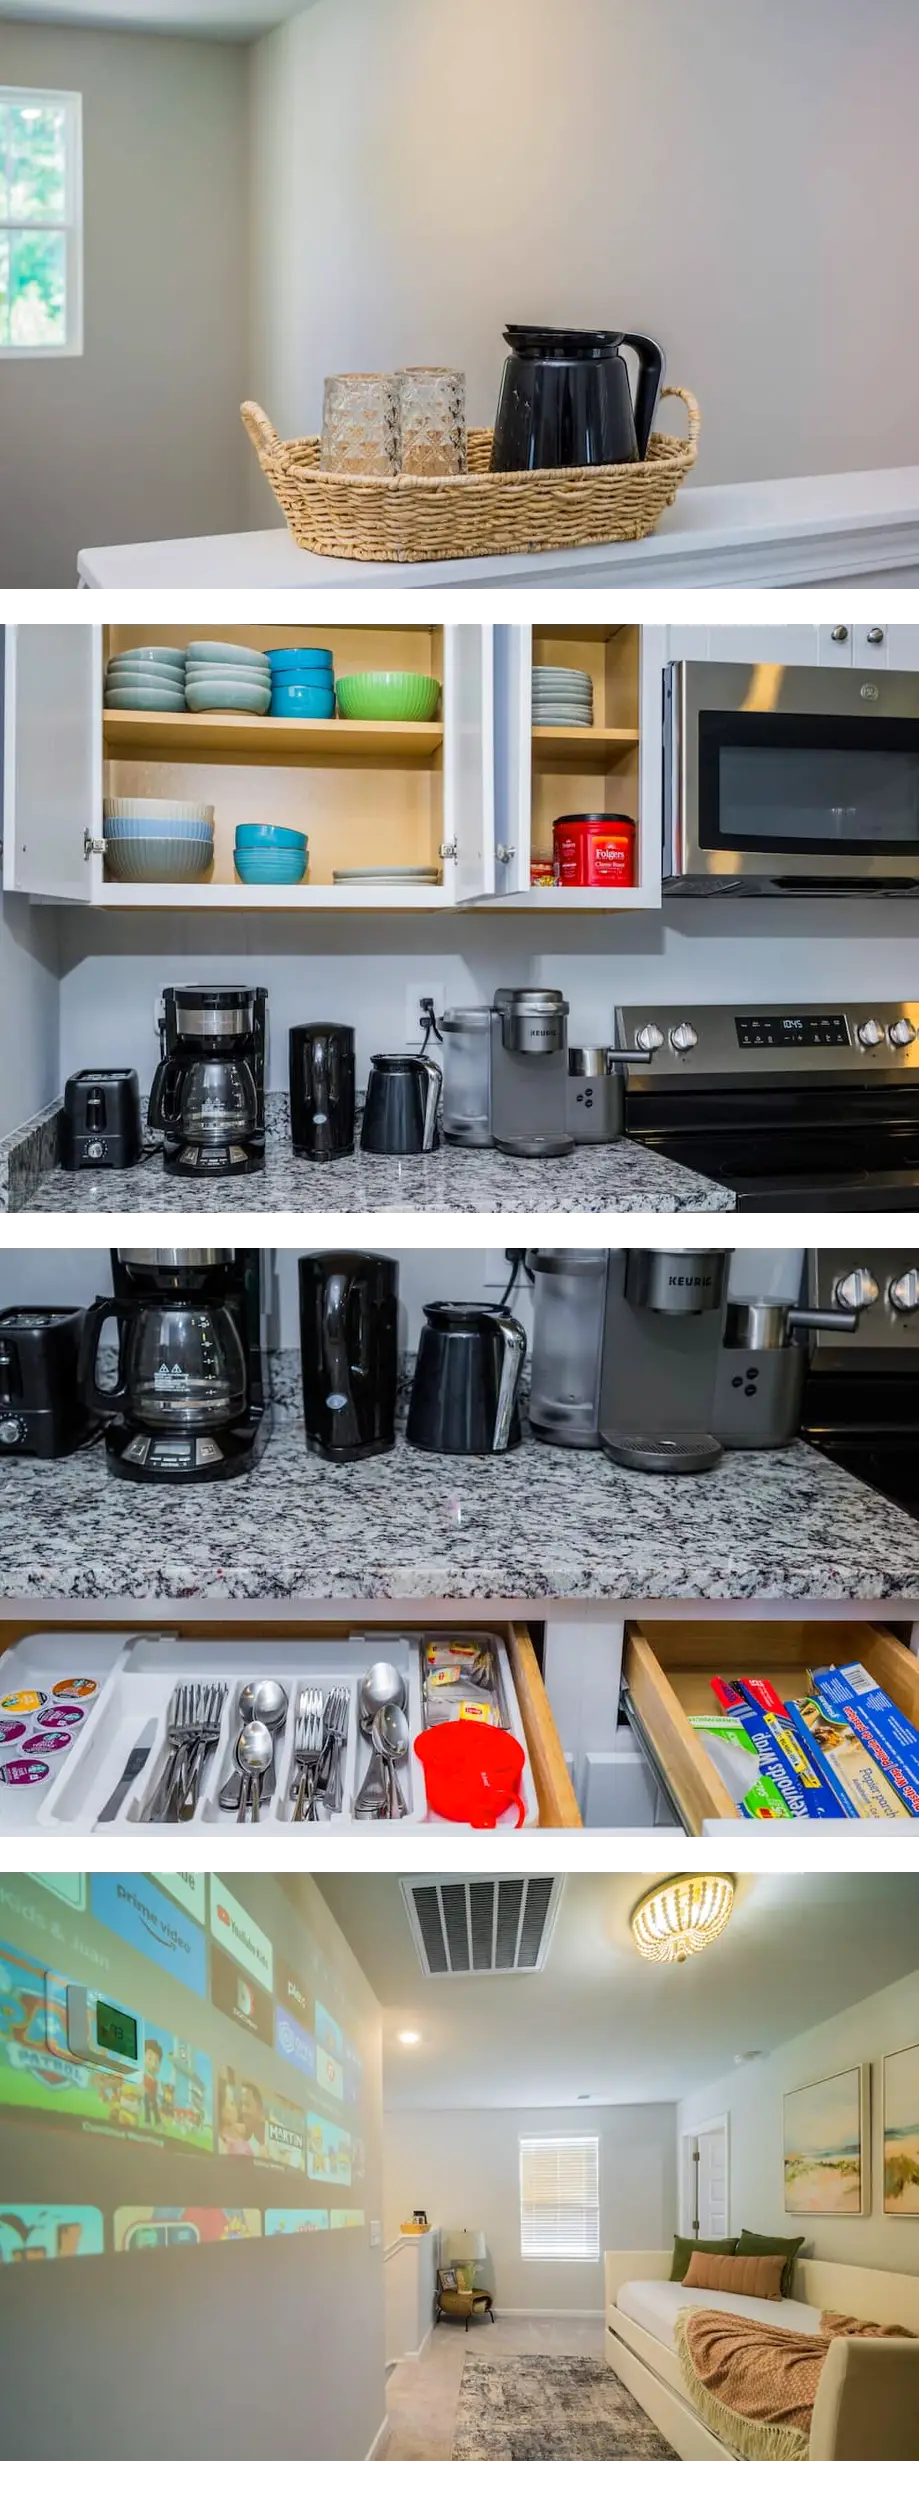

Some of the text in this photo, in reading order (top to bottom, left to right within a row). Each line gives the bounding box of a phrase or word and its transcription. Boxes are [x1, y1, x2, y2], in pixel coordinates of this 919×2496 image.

[596, 849, 625, 860] Folgers
[668, 1276, 712, 1287] KEURIG
[843, 1705, 868, 1731] plastique
[751, 1733, 778, 1766] Wrap
[867, 1739, 891, 1766] Pellicule
[859, 1767, 880, 1793] Papier
[888, 1768, 909, 1787] Wrap
[116, 1883, 192, 1954] prime video
[18, 2050, 84, 2081] PATROL
[269, 2123, 303, 2148] MARTIN
